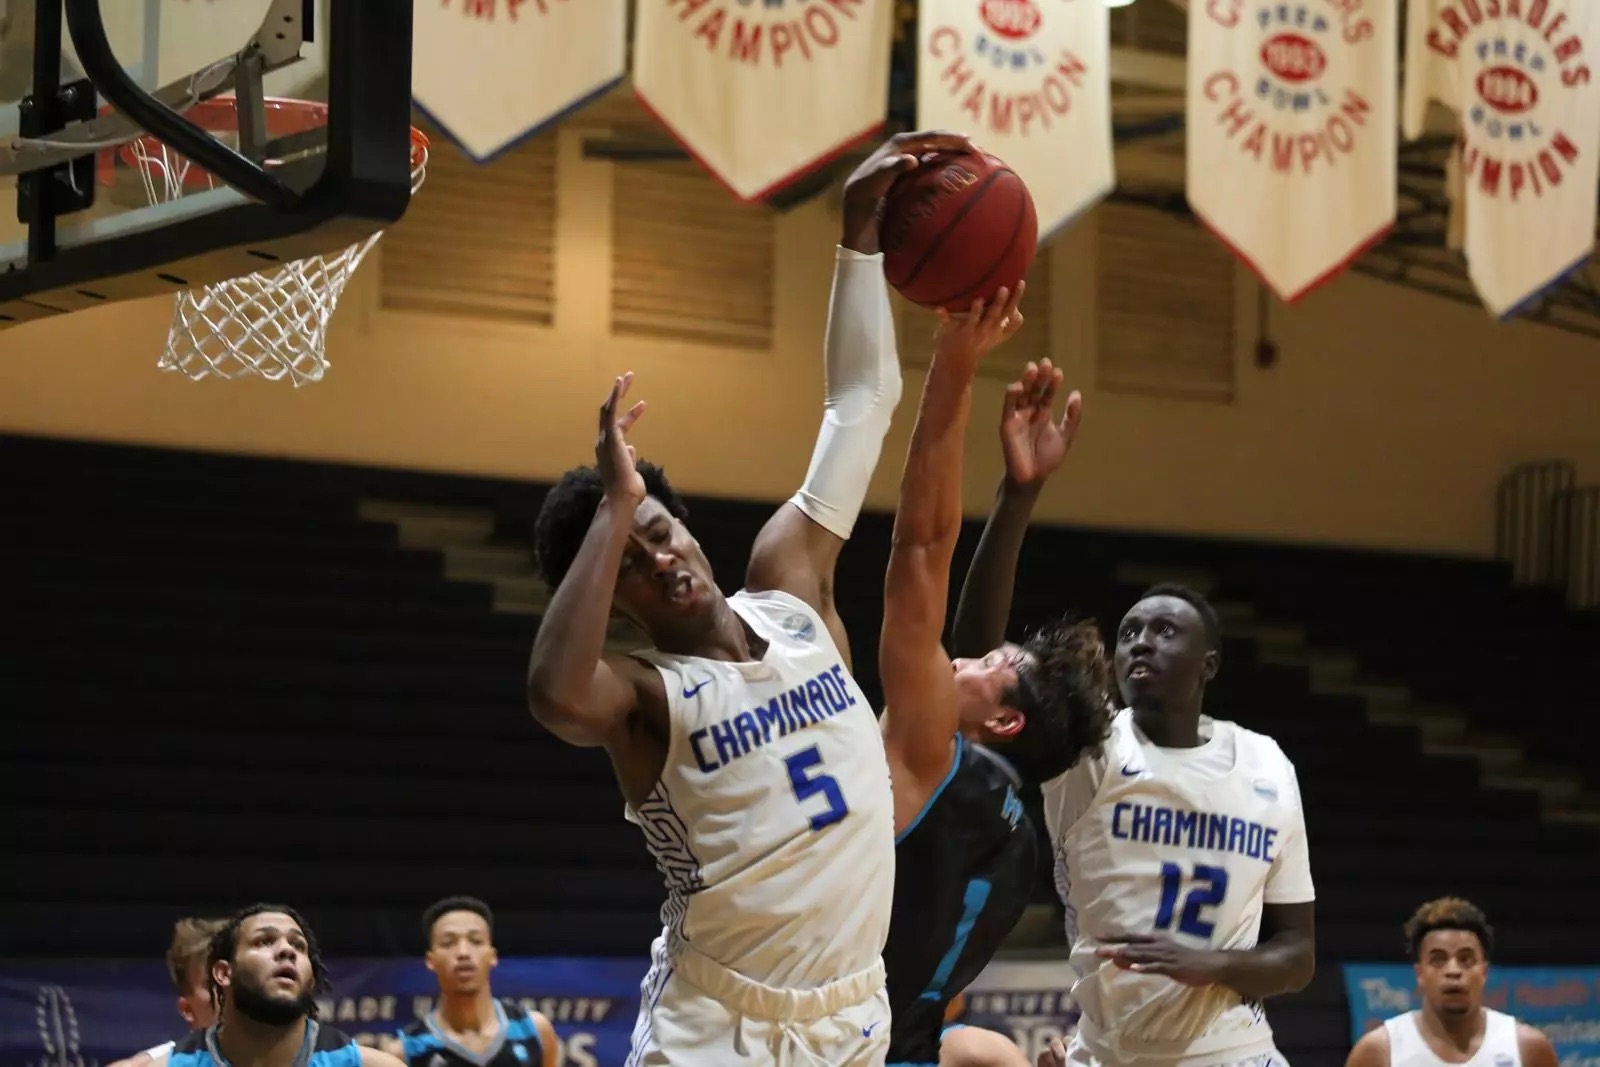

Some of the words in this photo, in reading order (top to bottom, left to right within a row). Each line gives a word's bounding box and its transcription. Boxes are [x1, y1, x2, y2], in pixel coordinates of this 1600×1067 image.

[929, 26, 1087, 136] CHAMPION
[1204, 69, 1371, 173] CHAMPION
[689, 664, 856, 774] CHAMINADE
[783, 744, 849, 831] 5
[1111, 801, 1278, 862] CHAMINADE
[1154, 861, 1228, 938] 12
